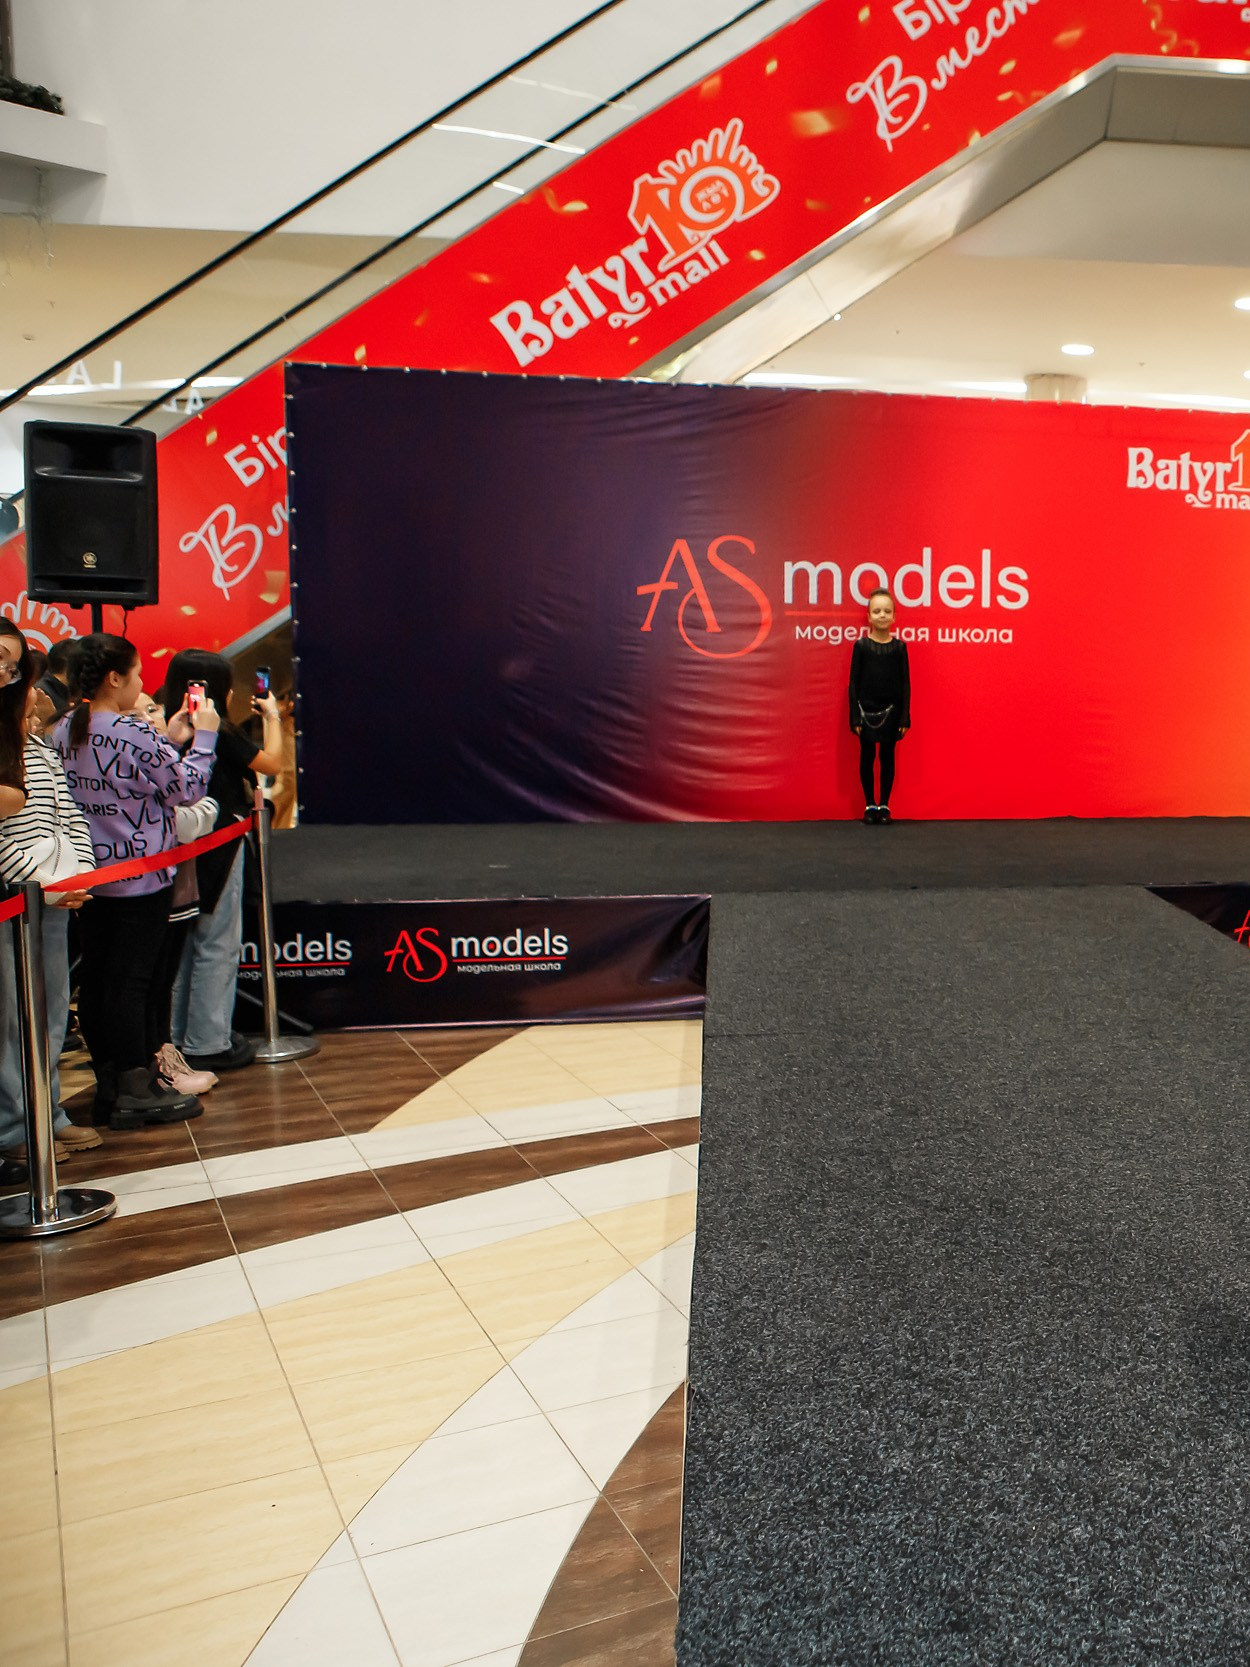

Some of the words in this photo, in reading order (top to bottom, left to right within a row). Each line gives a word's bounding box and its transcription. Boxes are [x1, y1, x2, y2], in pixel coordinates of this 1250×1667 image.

[490, 237, 656, 367] Batyr
[648, 240, 730, 306] mall
[1127, 447, 1232, 508] Batyr
[636, 534, 773, 659] AS
[785, 547, 1030, 610] models
[795, 625, 930, 645] моделная
[938, 627, 1013, 644] школа
[384, 927, 448, 982] AS
[451, 928, 569, 957] models
[457, 964, 522, 975] модельная
[524, 962, 562, 972] школа
